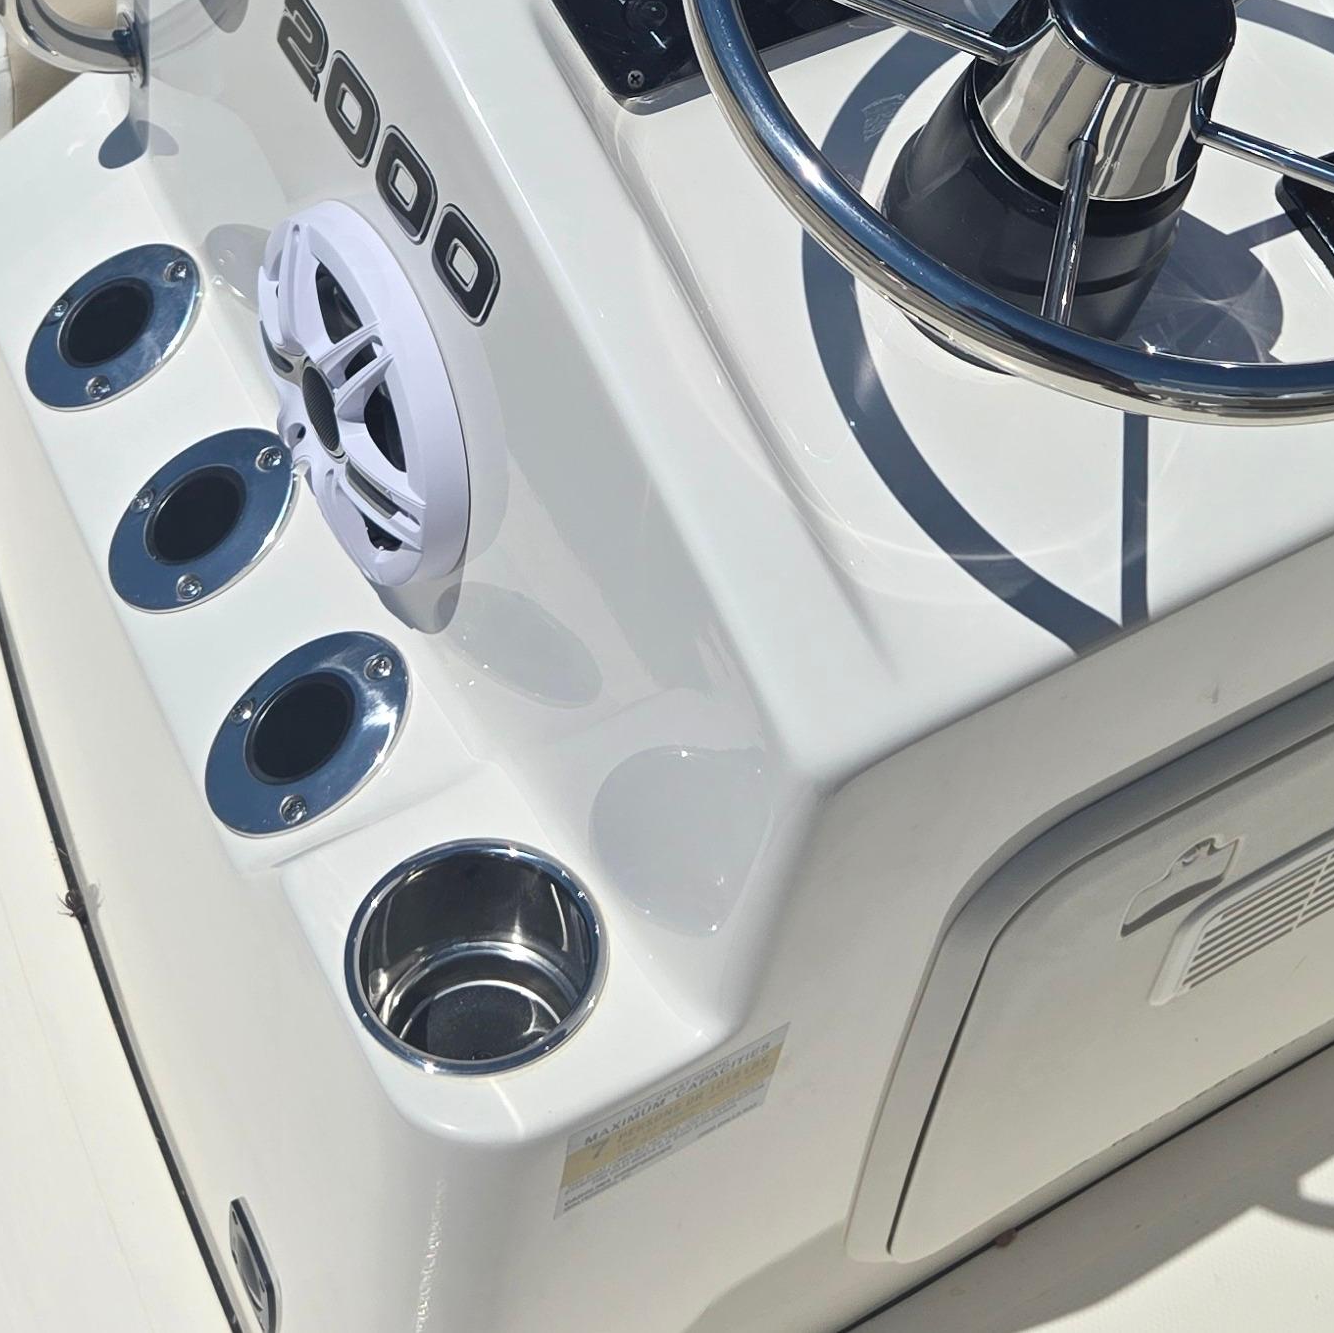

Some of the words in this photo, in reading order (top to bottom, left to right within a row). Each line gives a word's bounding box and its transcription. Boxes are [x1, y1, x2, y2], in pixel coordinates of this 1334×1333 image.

[584, 1098, 666, 1146] MAXIMUM
[675, 1041, 770, 1099] CAPACITIES
[592, 1137, 610, 1160] 7
